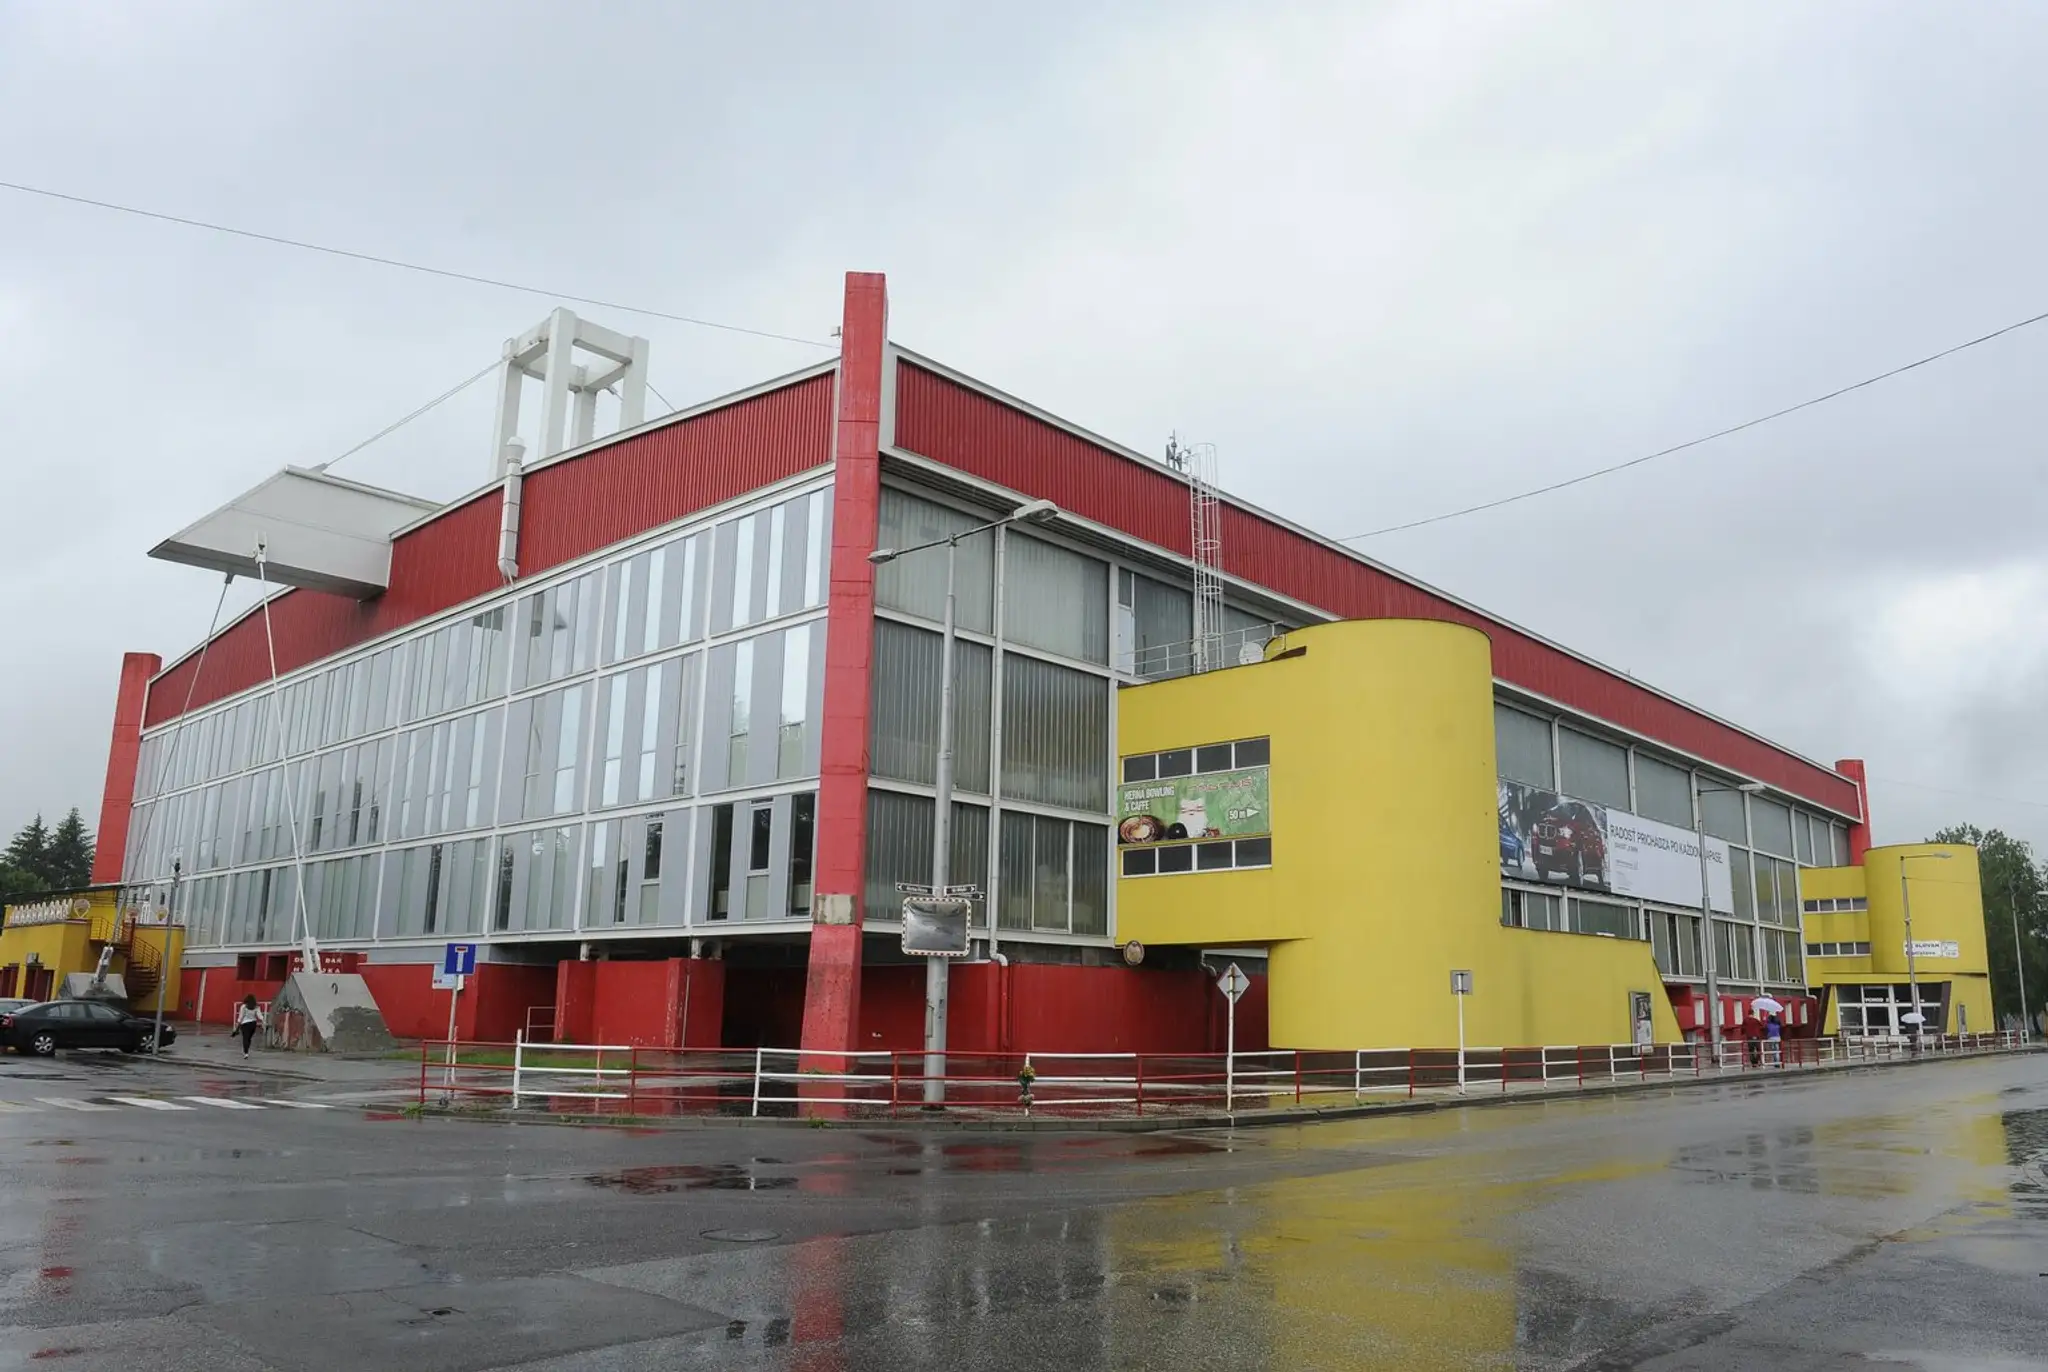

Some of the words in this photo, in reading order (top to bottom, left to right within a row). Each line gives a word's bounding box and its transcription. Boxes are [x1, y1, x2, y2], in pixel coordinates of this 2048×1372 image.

[1146, 786, 1175, 798] BOWLING
[1229, 809, 1239, 820] 50
[1671, 840, 1678, 853] PO
